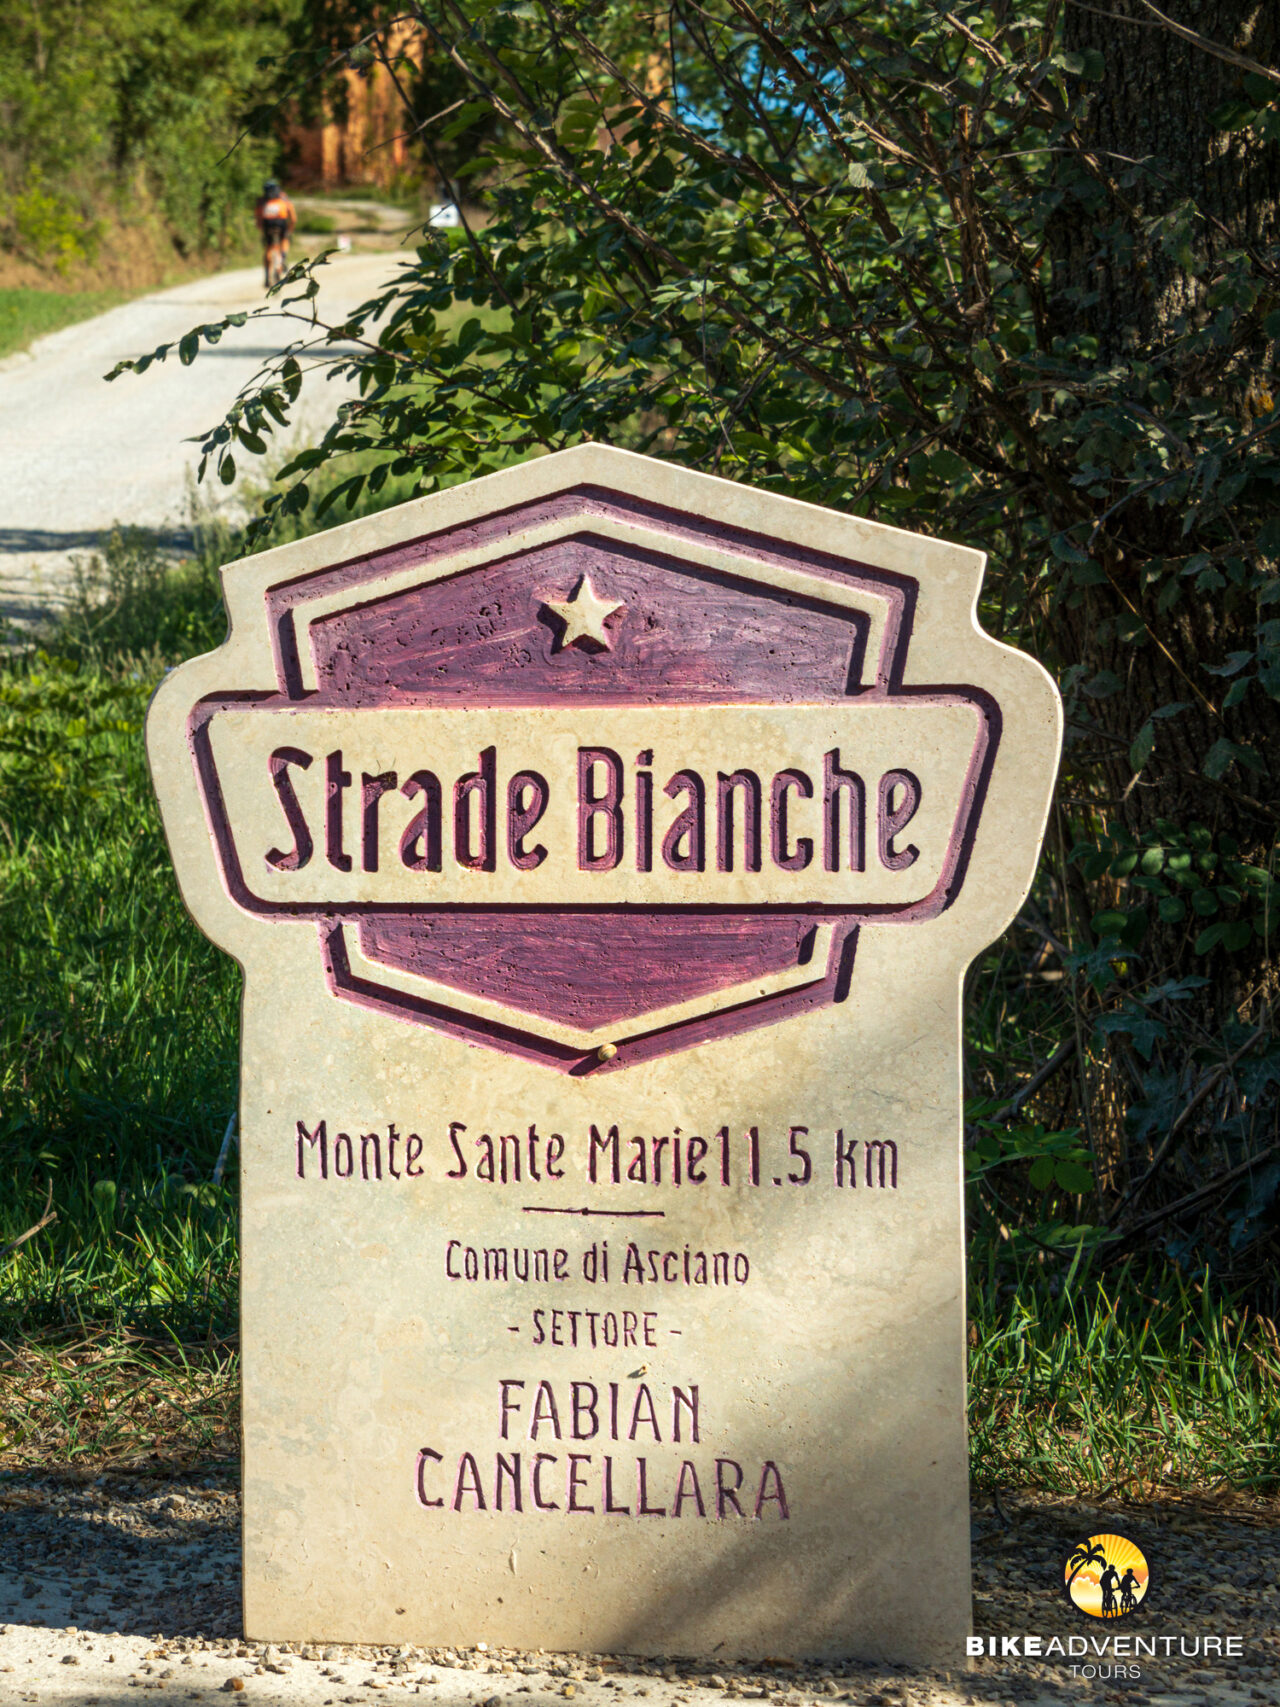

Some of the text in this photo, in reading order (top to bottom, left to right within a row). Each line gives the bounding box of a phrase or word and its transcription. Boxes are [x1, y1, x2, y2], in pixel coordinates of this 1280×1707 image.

[265, 745, 920, 875] Strade Bianche
[295, 1120, 898, 1189] Monte Sante Marie 11.5 km
[445, 1240, 750, 1287] Comune di Asciano
[532, 1309, 658, 1347] SETTORE
[415, 1449, 791, 1521] CANCELLARA
